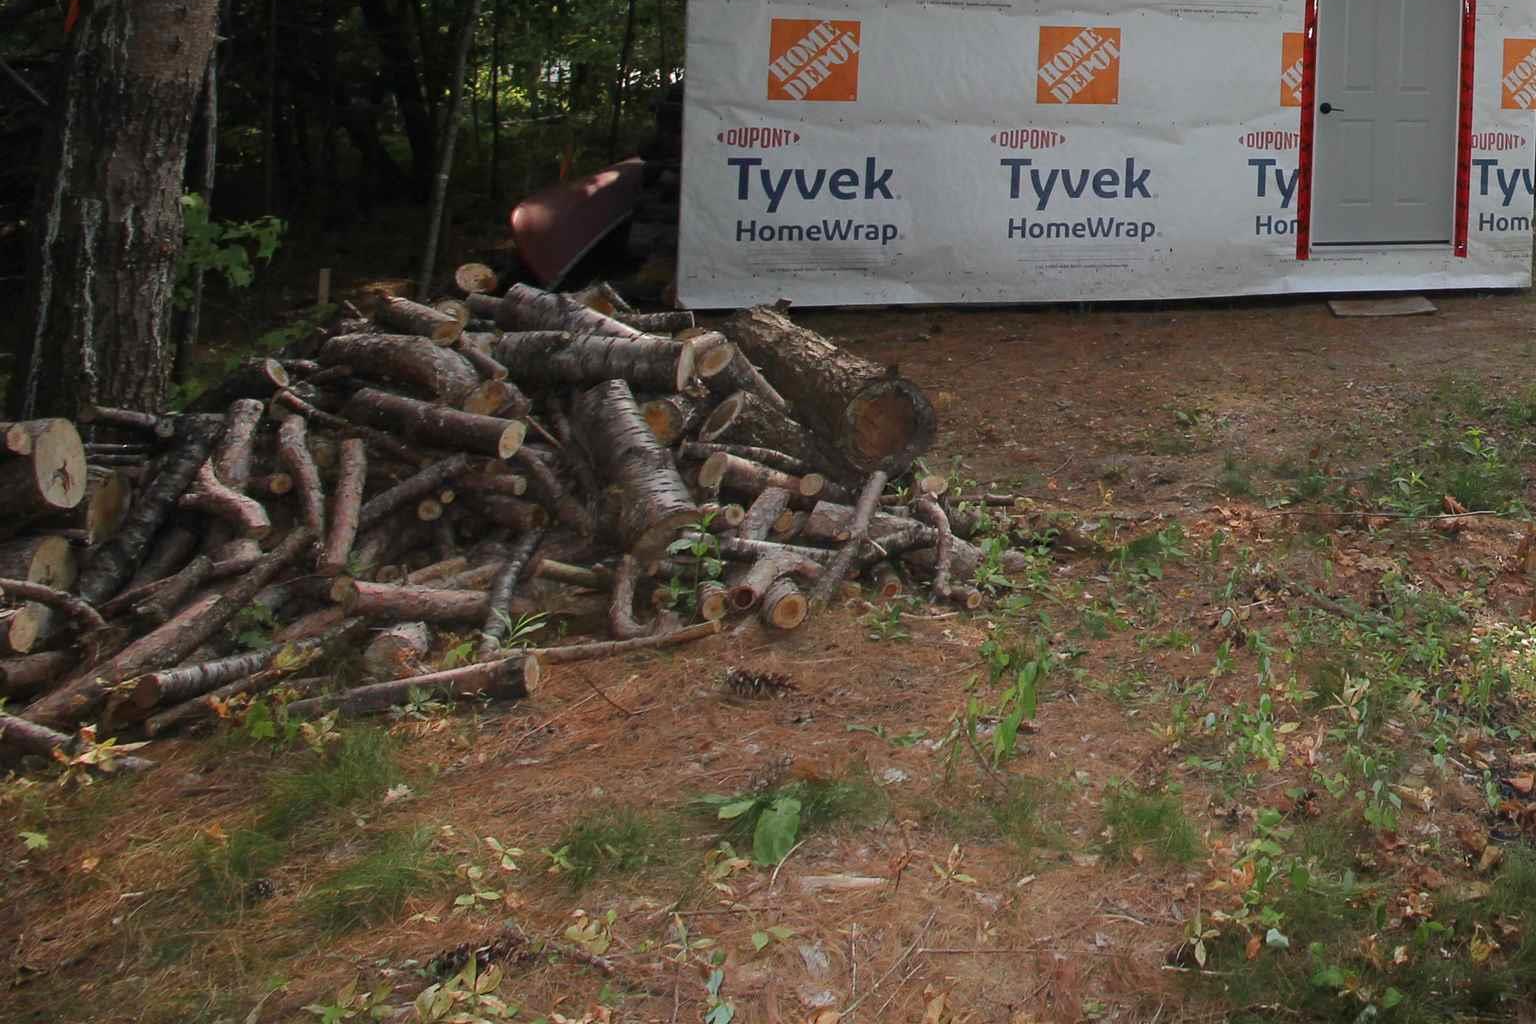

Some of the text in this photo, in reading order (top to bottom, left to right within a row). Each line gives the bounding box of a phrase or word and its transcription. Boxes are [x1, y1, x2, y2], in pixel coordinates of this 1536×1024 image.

[768, 22, 841, 81] HOME
[783, 32, 861, 101] DEPOT
[1039, 28, 1103, 86] HOME
[1050, 38, 1120, 104] DEPOT
[727, 127, 792, 149] DUPONT
[1000, 129, 1058, 150] DUPONT
[727, 157, 894, 213] Tyvek
[1000, 157, 1152, 211] Tyvek
[736, 219, 898, 245] HomeWrap
[1008, 217, 1155, 242] HomeWrap
